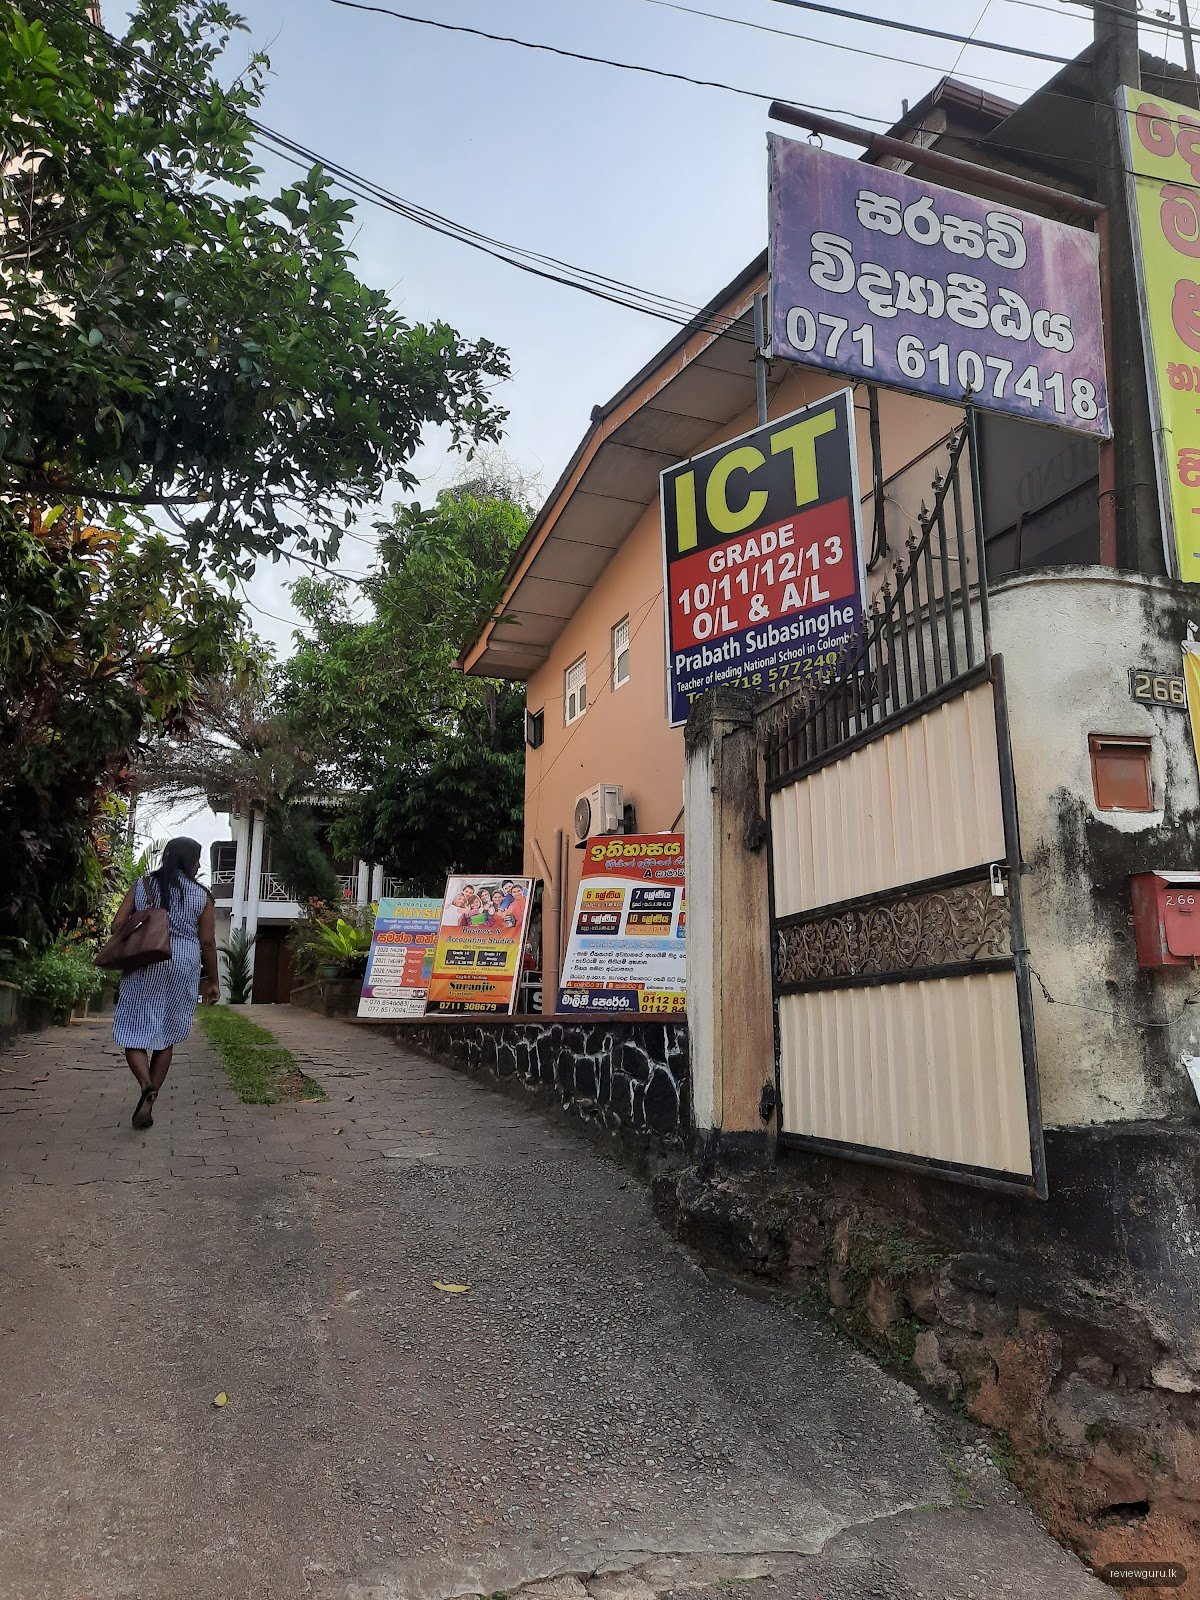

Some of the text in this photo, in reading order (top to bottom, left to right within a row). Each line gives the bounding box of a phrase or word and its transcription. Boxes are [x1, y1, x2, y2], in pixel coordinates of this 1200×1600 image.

[856, 190, 1028, 269] සරසවි
[786, 306, 873, 368] 071
[897, 335, 1098, 420] 6107418
[675, 408, 837, 553] ICT
[708, 523, 795, 573] GRADE
[678, 535, 843, 615] 10/11/12/13
[693, 574, 830, 641] O/L & A/L
[676, 606, 854, 675] Prabath Subasinghe
[677, 632, 852, 693] Teacher of leading National School in Colomb
[1134, 673, 1184, 704] 266
[586, 890, 592, 899] 6
[635, 890, 641, 899] 7
[1166, 895, 1195, 906] 266
[581, 914, 588, 922] 9
[629, 914, 638, 923] 10
[439, 1002, 461, 1010] 0711
[641, 1004, 667, 1013] 0112
[643, 995, 669, 1004] 0112
